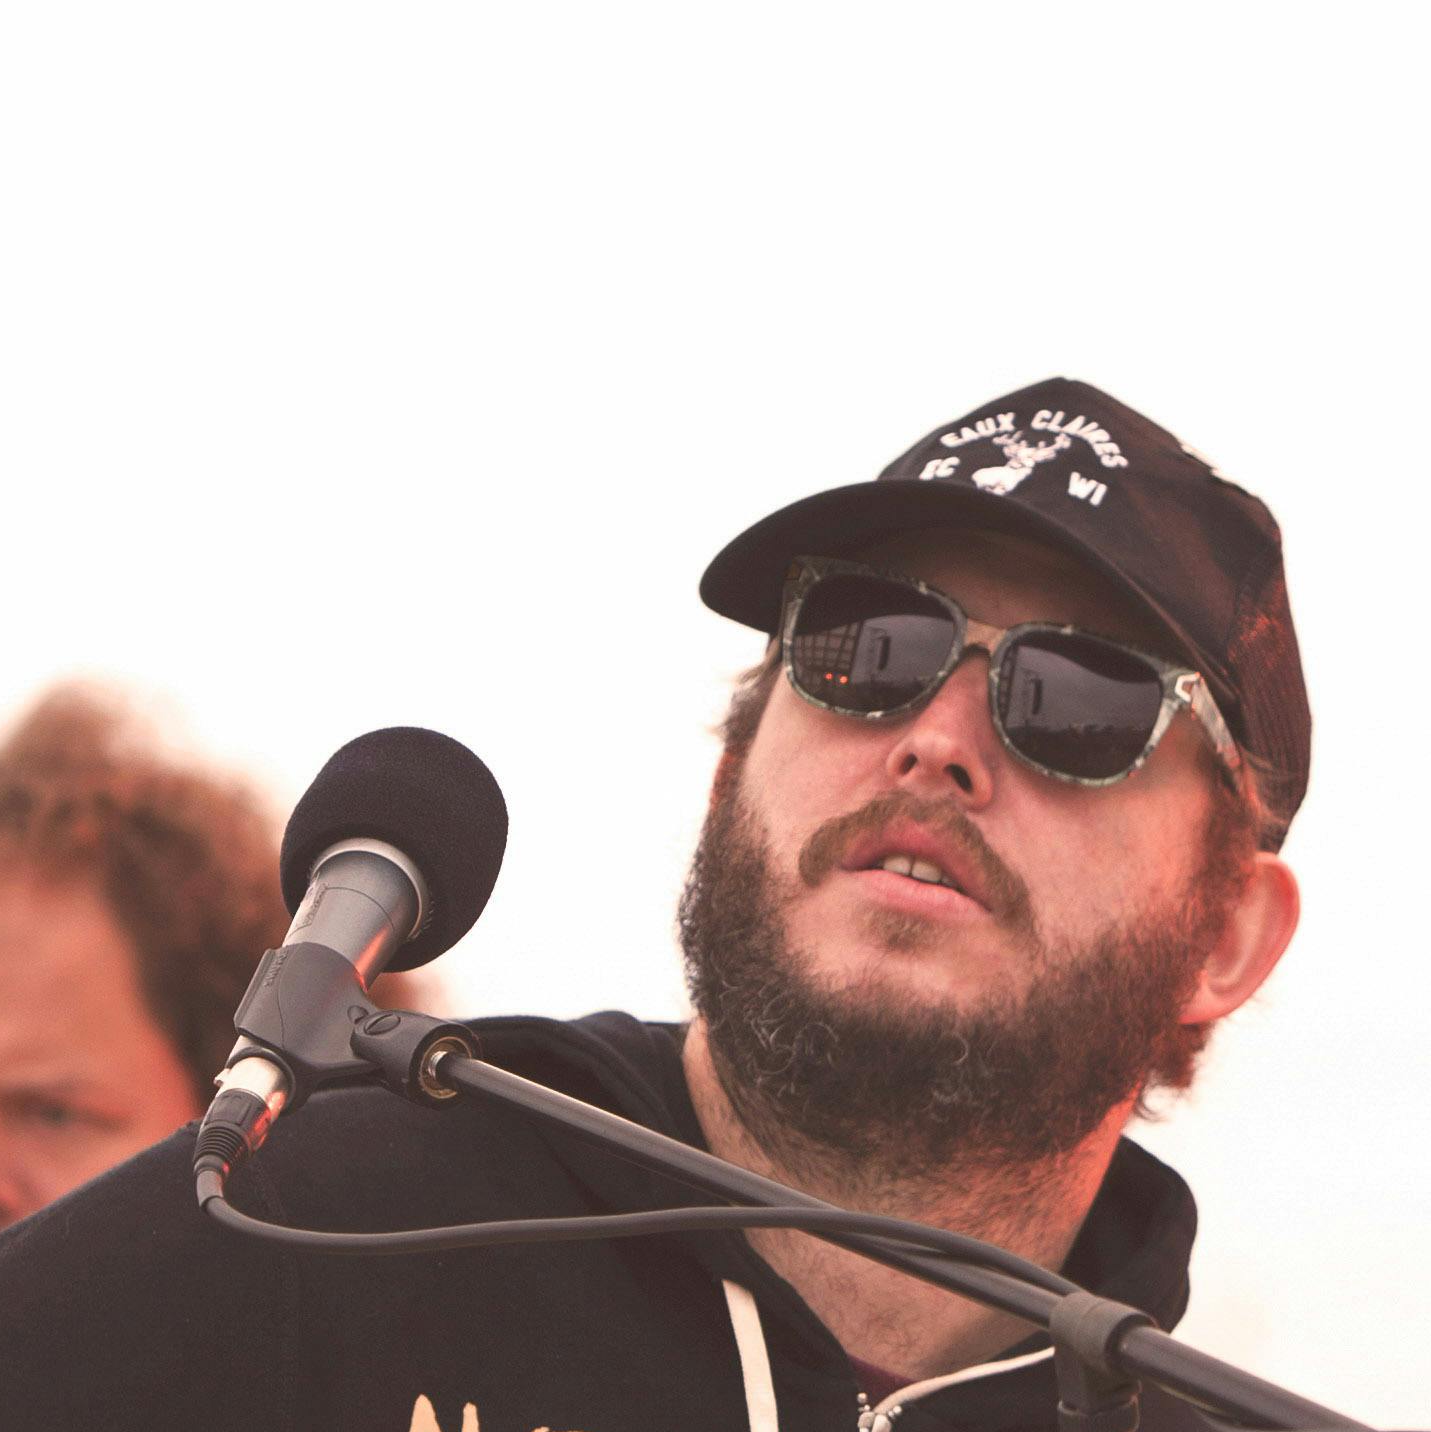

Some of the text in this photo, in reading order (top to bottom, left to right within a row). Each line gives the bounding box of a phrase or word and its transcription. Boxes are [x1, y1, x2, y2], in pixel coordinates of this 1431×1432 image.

[940, 409, 1128, 468] EAUX CLAIRES
[1068, 471, 1108, 506] WI
